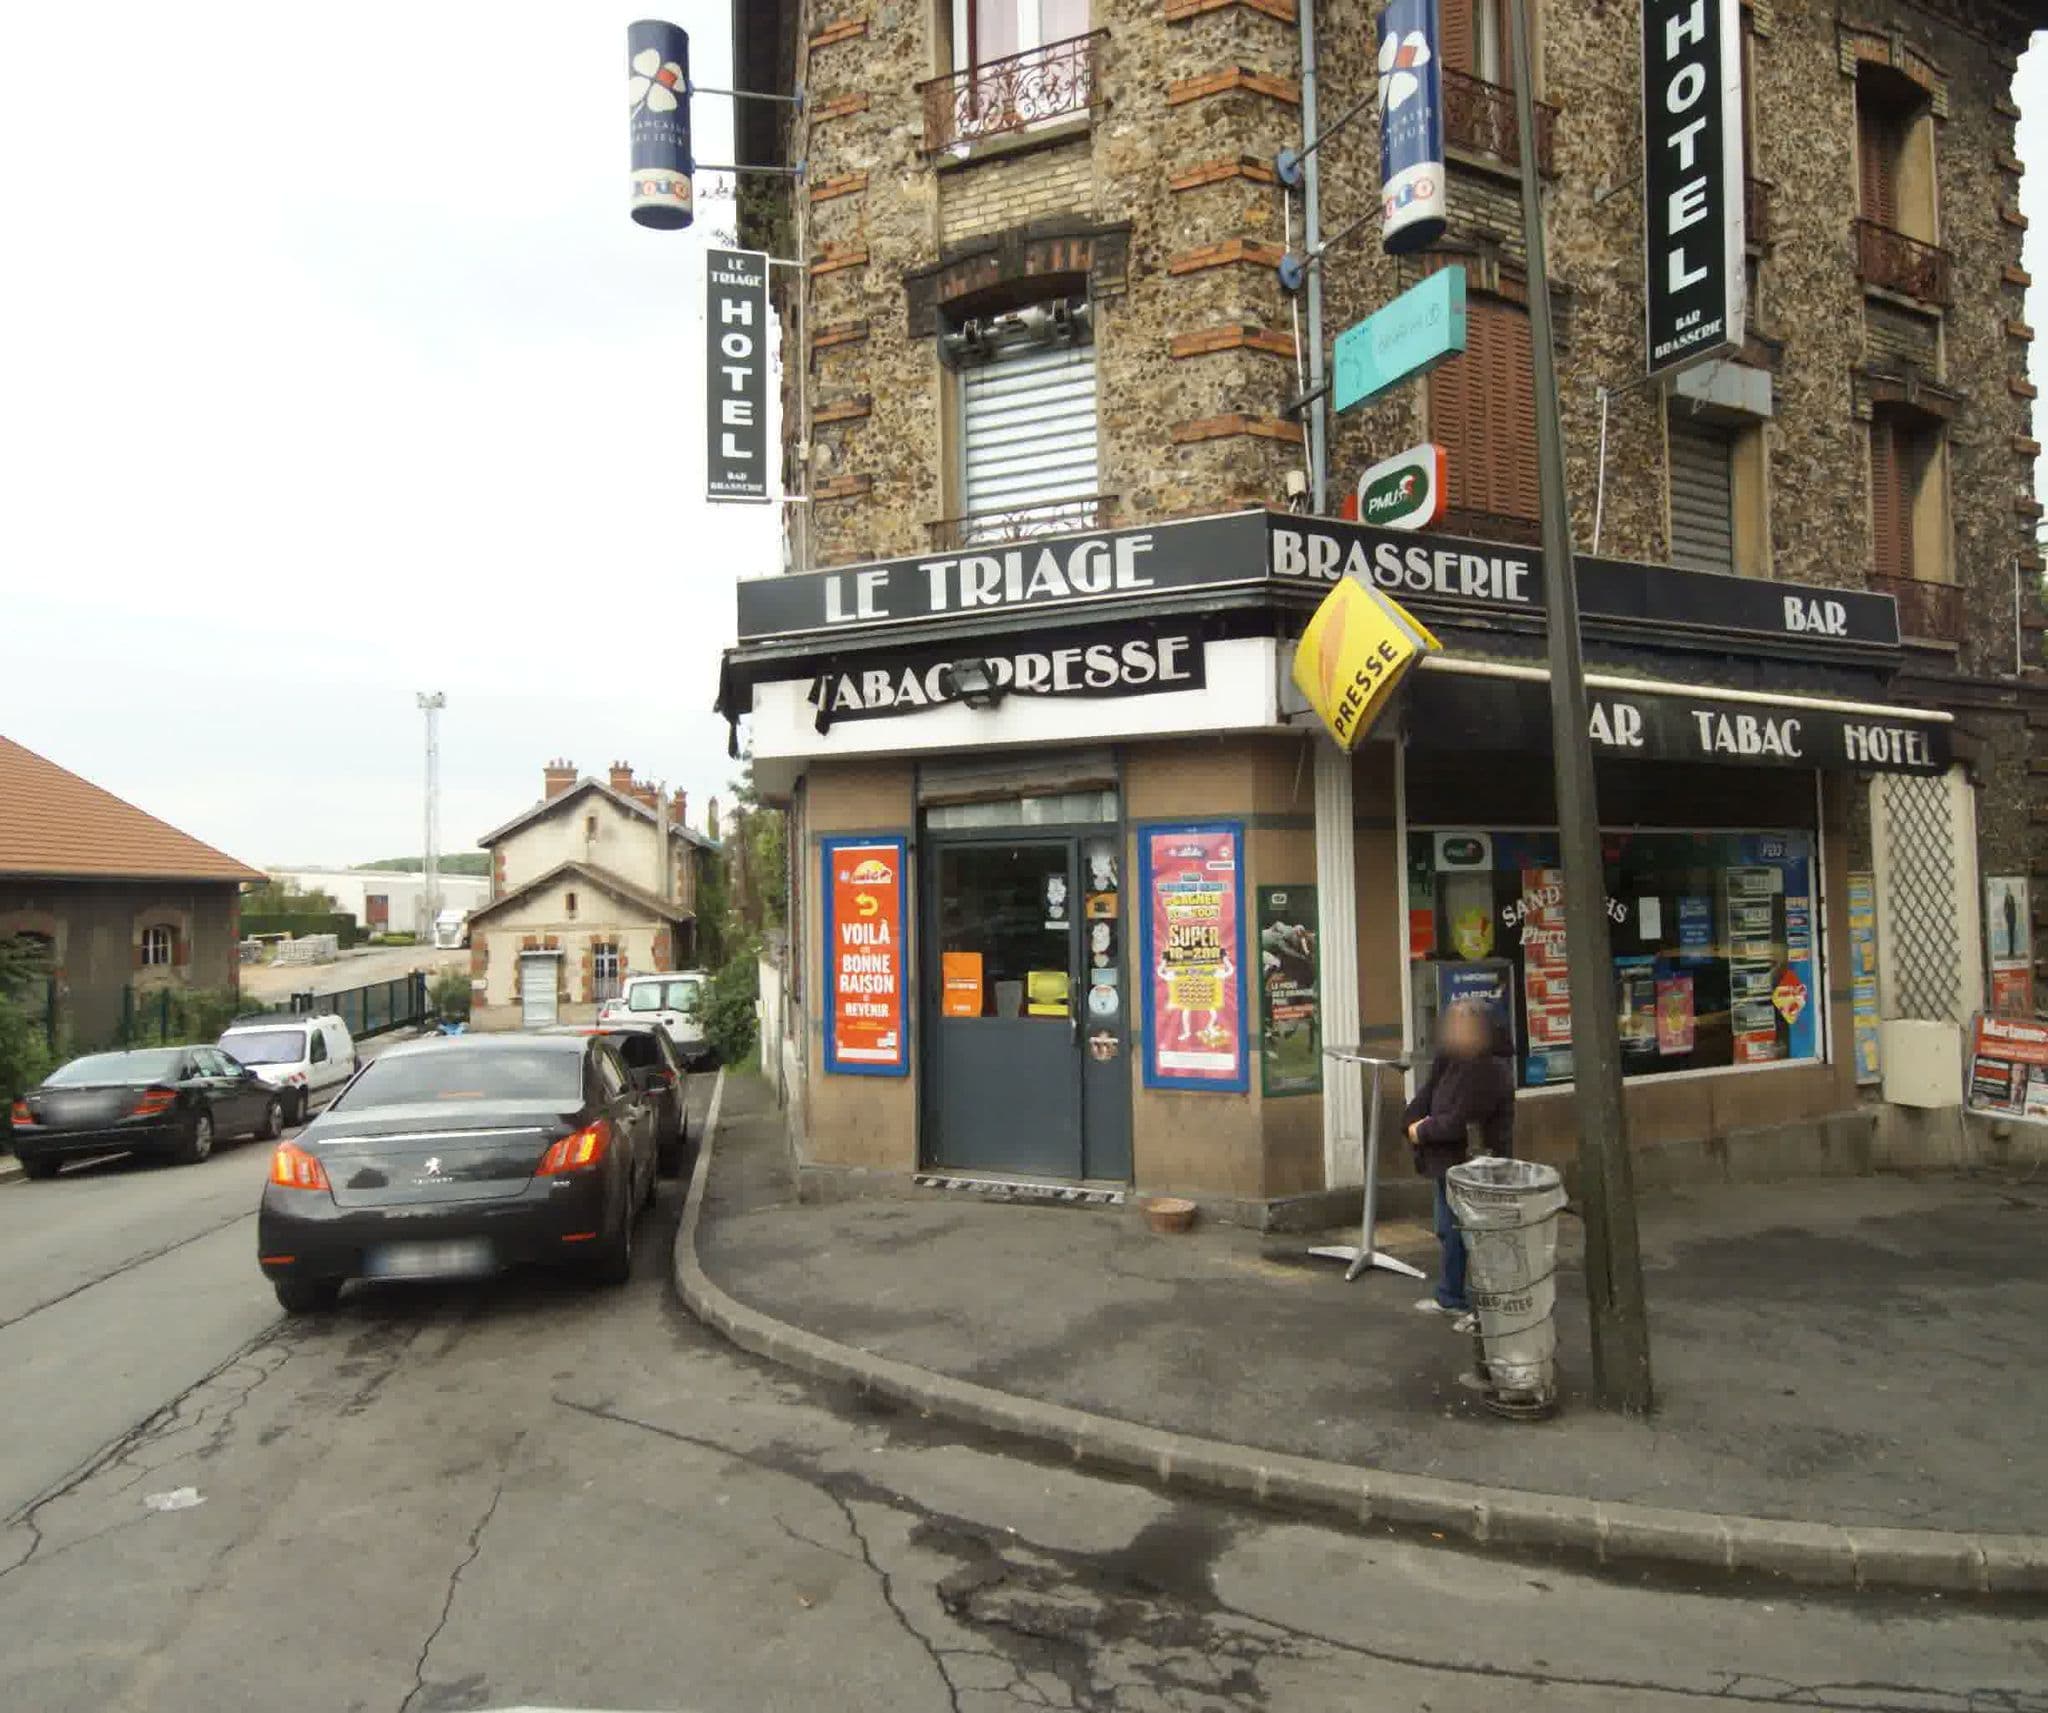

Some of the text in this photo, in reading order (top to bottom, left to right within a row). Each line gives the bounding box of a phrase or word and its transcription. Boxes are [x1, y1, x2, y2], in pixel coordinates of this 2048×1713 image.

[1666, 1, 1708, 295] HOTEL
[711, 271, 762, 287] TRIAGE
[728, 259, 745, 271] LE
[1675, 309, 1701, 332] BAR
[721, 299, 754, 459] HOTEL
[825, 534, 1155, 623] LE TRIAGE
[1273, 529, 1529, 602] BRASSERIE
[1783, 596, 1848, 637] BAR
[985, 636, 1190, 693] PRESSE
[1333, 639, 1399, 737] PRESSE
[1589, 702, 1938, 767] AR TABAC HOTEL
[842, 919, 891, 945] VOILÀ
[1169, 923, 1220, 947] SUPER
[842, 953, 891, 974] BONNE
[840, 974, 895, 995] RAISON
